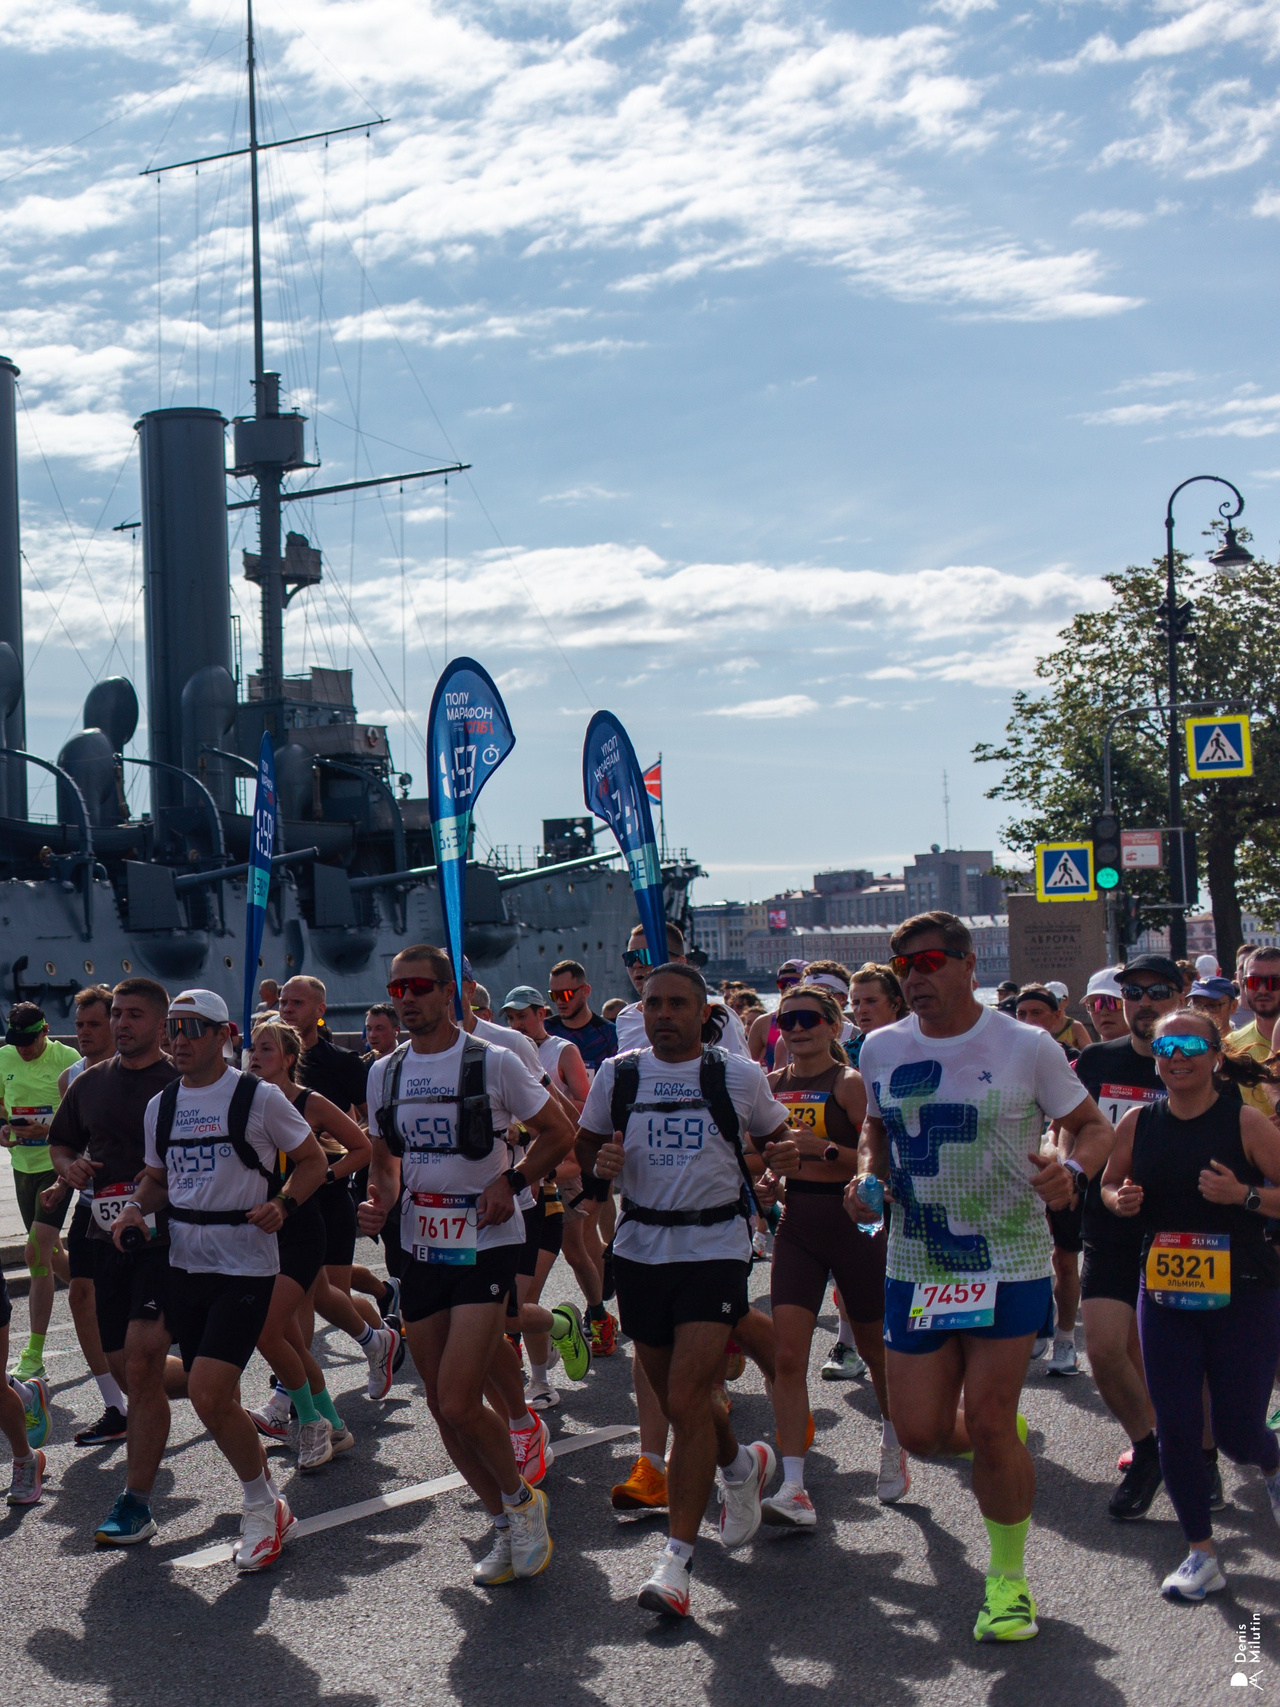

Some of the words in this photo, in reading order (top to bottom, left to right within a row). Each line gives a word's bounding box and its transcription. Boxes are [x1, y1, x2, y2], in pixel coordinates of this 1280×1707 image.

[445, 692, 470, 706] ПОЛУ
[446, 706, 494, 721] МАРАФОН
[1032, 934, 1076, 944] АВРОРА
[407, 1078, 432, 1088] ПОЛУ
[406, 1087, 456, 1098] МАРАФОН
[654, 1089, 702, 1098] МАРАФО
[177, 1109, 201, 1119] ПОЛУ
[176, 1116, 222, 1127] МАРАФОН
[402, 1117, 454, 1148] 1:59
[648, 1117, 704, 1150] 1:59
[170, 1144, 216, 1174] 1:59
[410, 1153, 430, 1165] 5:38
[649, 1154, 674, 1166] 5:38
[177, 1178, 194, 1190] 5:38
[442, 1197, 453, 1205] 21,1
[418, 1215, 467, 1240] 7617
[1191, 1238, 1205, 1246] 21,1
[419, 1247, 428, 1260] E
[1156, 1253, 1216, 1280] 5321
[1167, 1279, 1206, 1289] ЭЛЬМИРА
[923, 1282, 987, 1308] 7459
[918, 1316, 929, 1328] E
